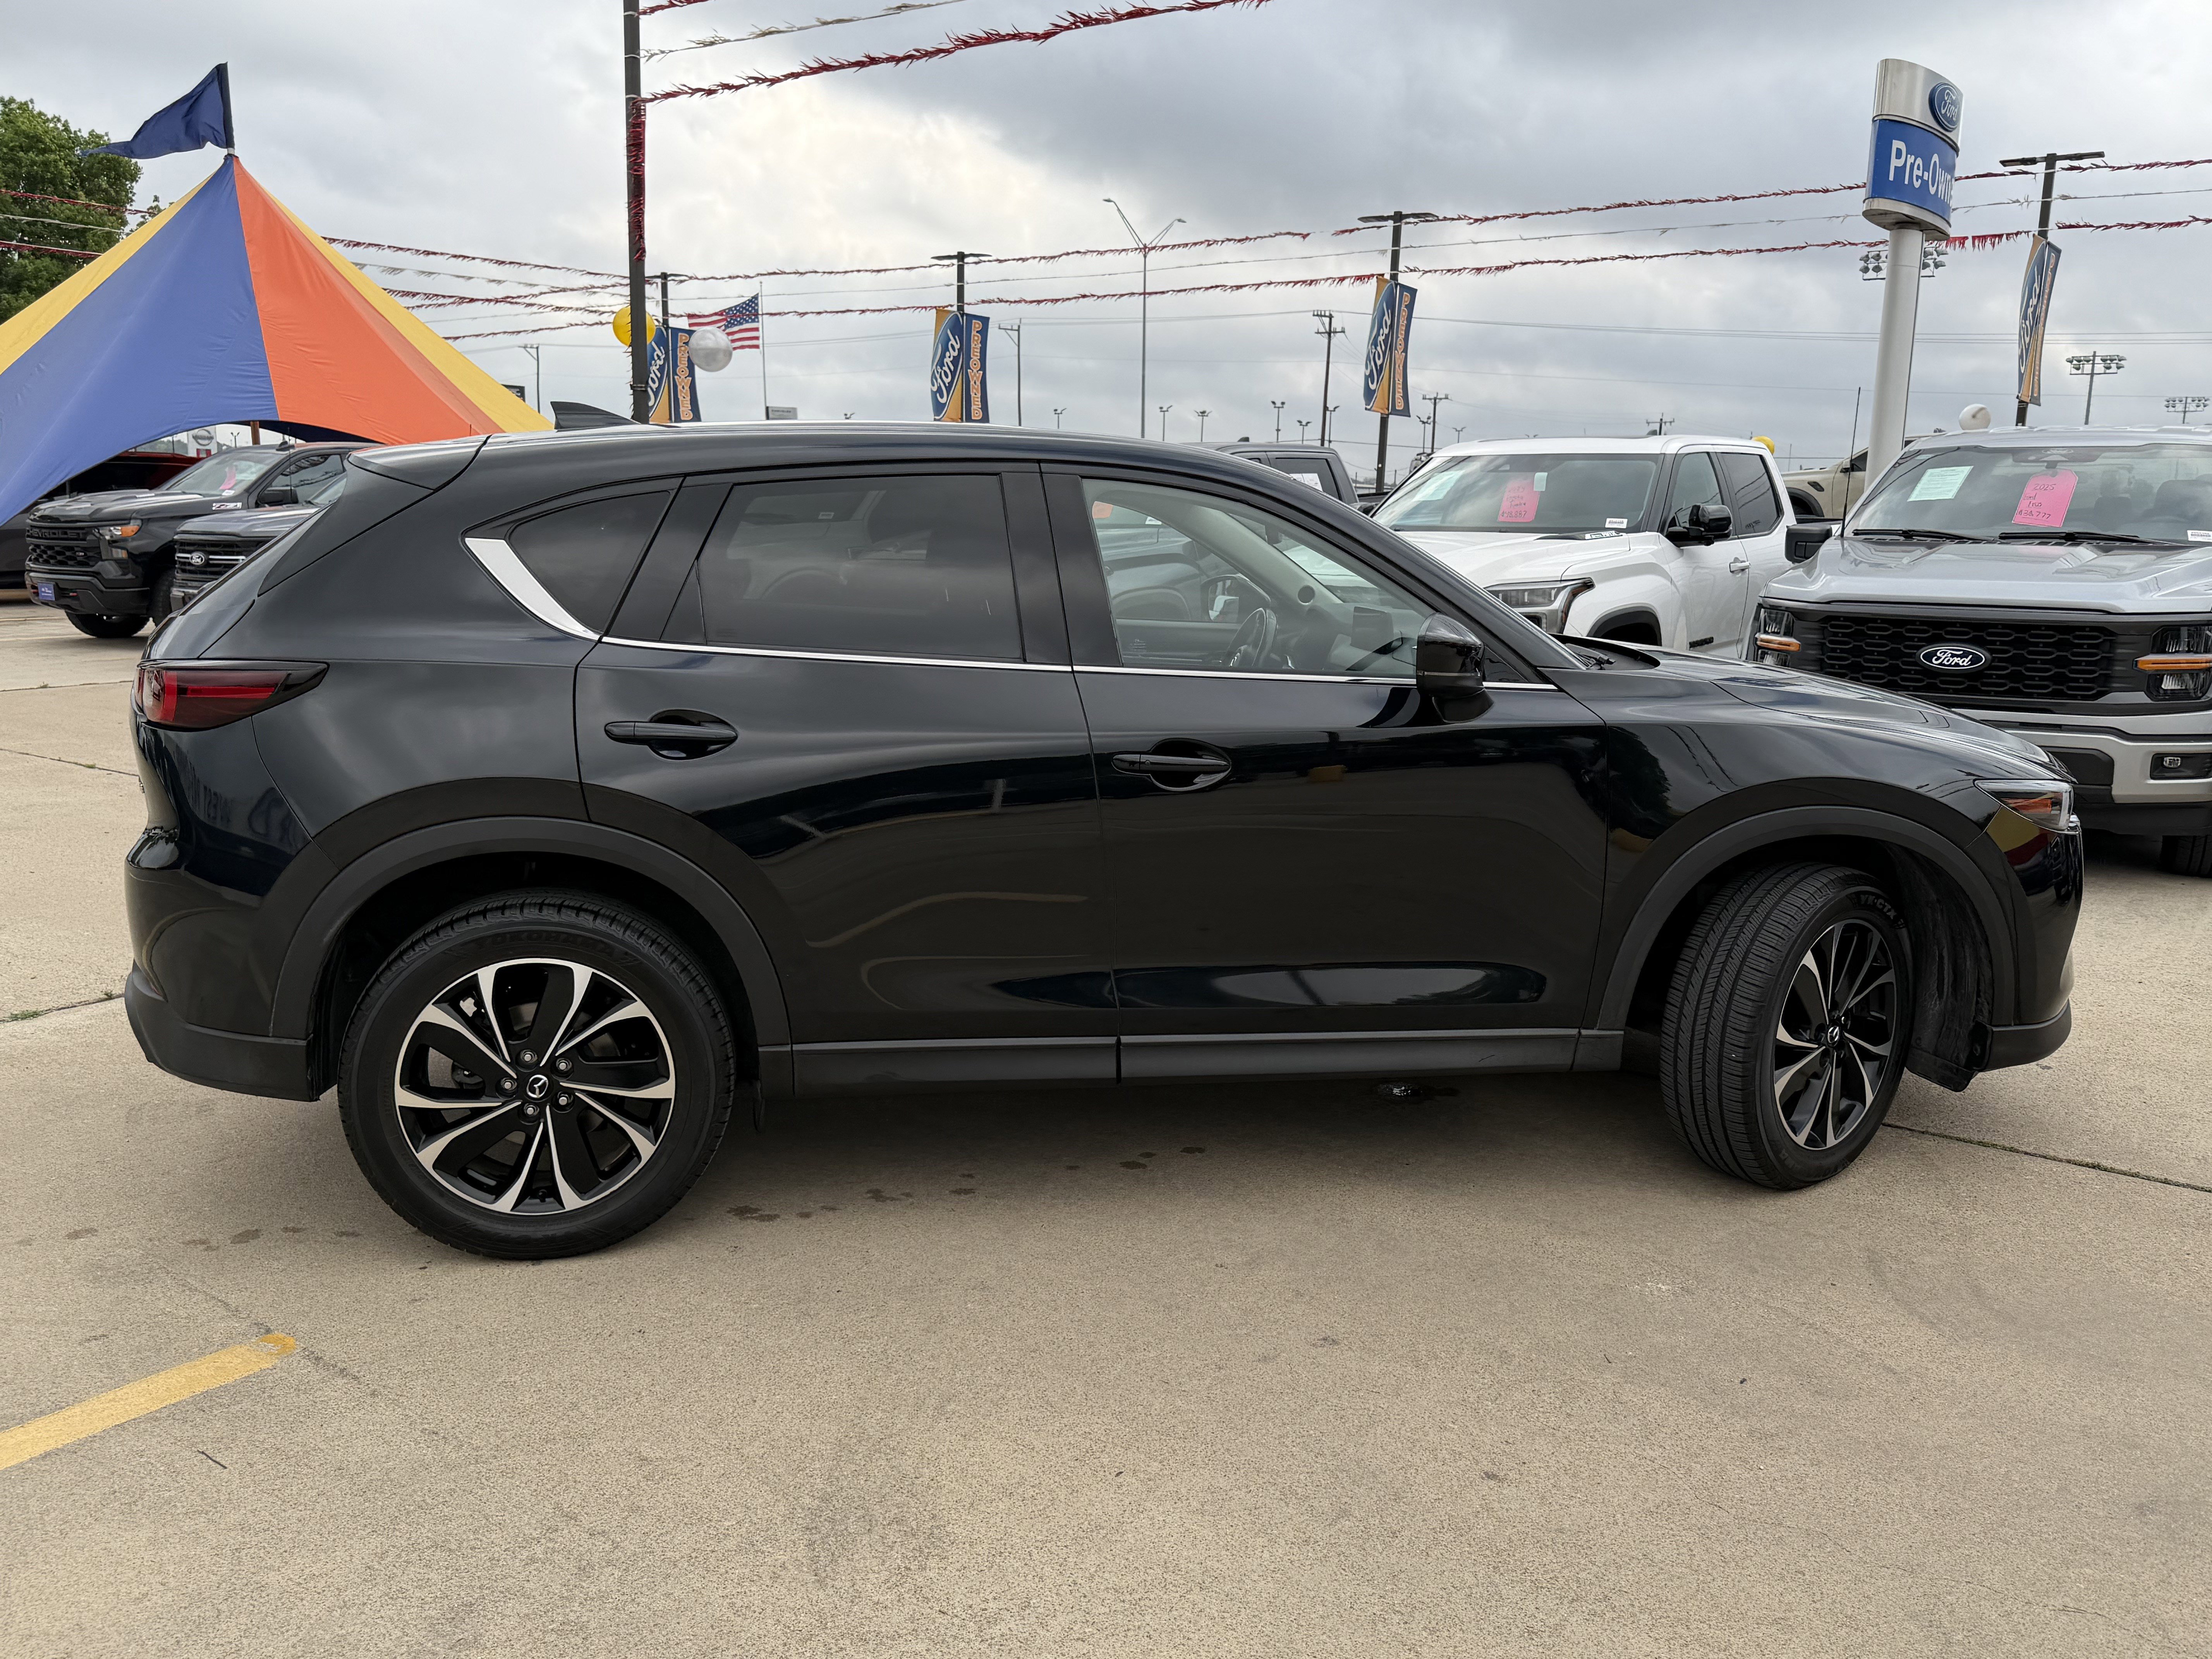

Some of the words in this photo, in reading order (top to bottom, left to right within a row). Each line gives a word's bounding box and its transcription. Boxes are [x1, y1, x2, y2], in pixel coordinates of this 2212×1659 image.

[1941, 89, 1959, 122] Ford
[1364, 301, 1391, 390] Ford
[2019, 266, 2040, 374] Ford
[674, 332, 693, 421] PREOWNED
[930, 329, 961, 404] Ford
[968, 319, 983, 420] PREOWNED
[1932, 649, 1973, 666] Ford
